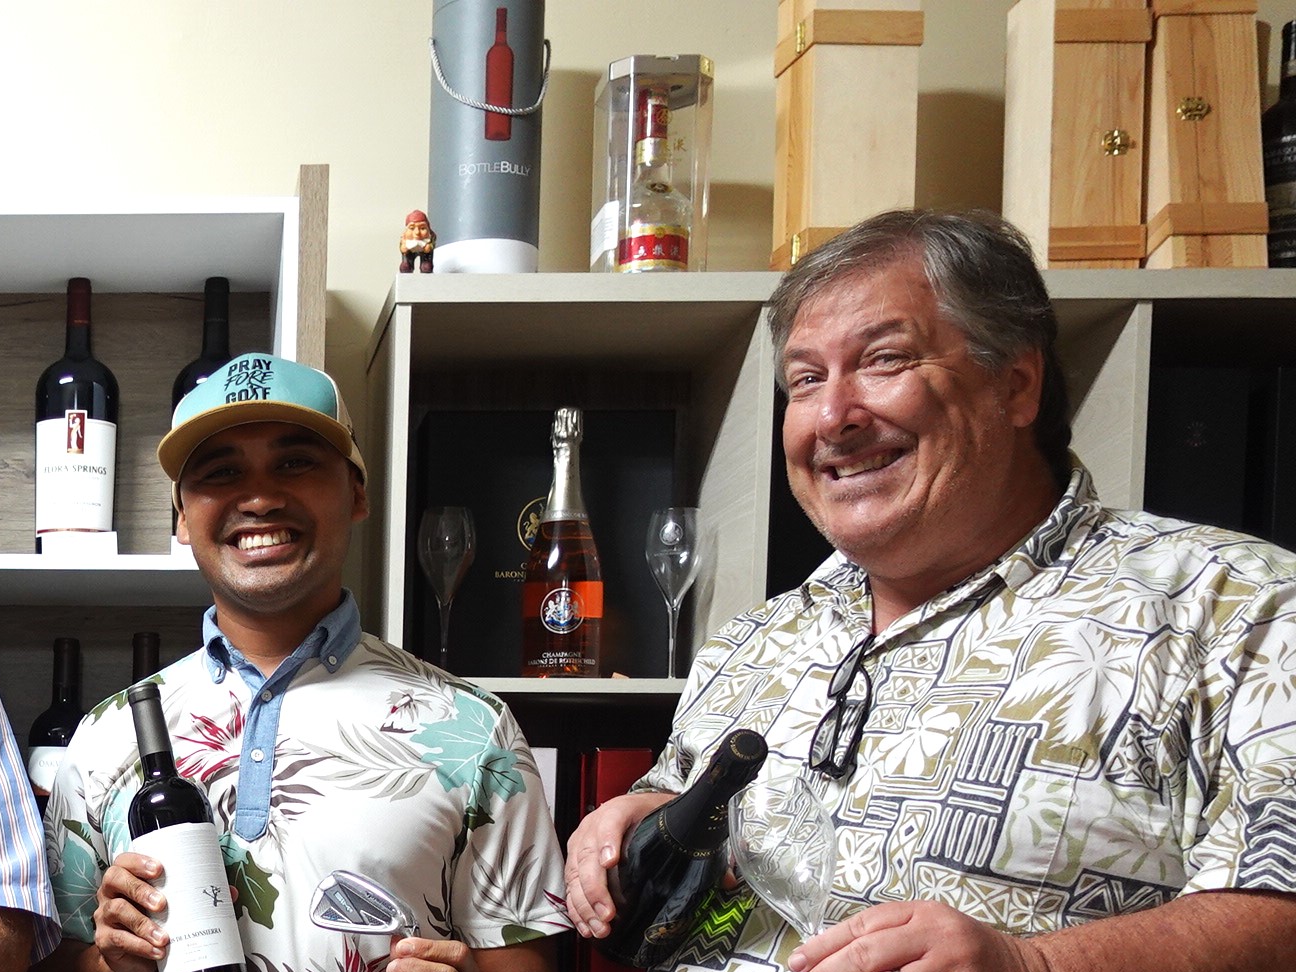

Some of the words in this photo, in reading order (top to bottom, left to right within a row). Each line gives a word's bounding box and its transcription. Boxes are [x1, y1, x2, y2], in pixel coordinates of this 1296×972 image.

[227, 358, 273, 377] PRAY
[223, 370, 274, 391] FORE
[72, 464, 108, 476] SPRINGS
[494, 571, 526, 579] BARON
